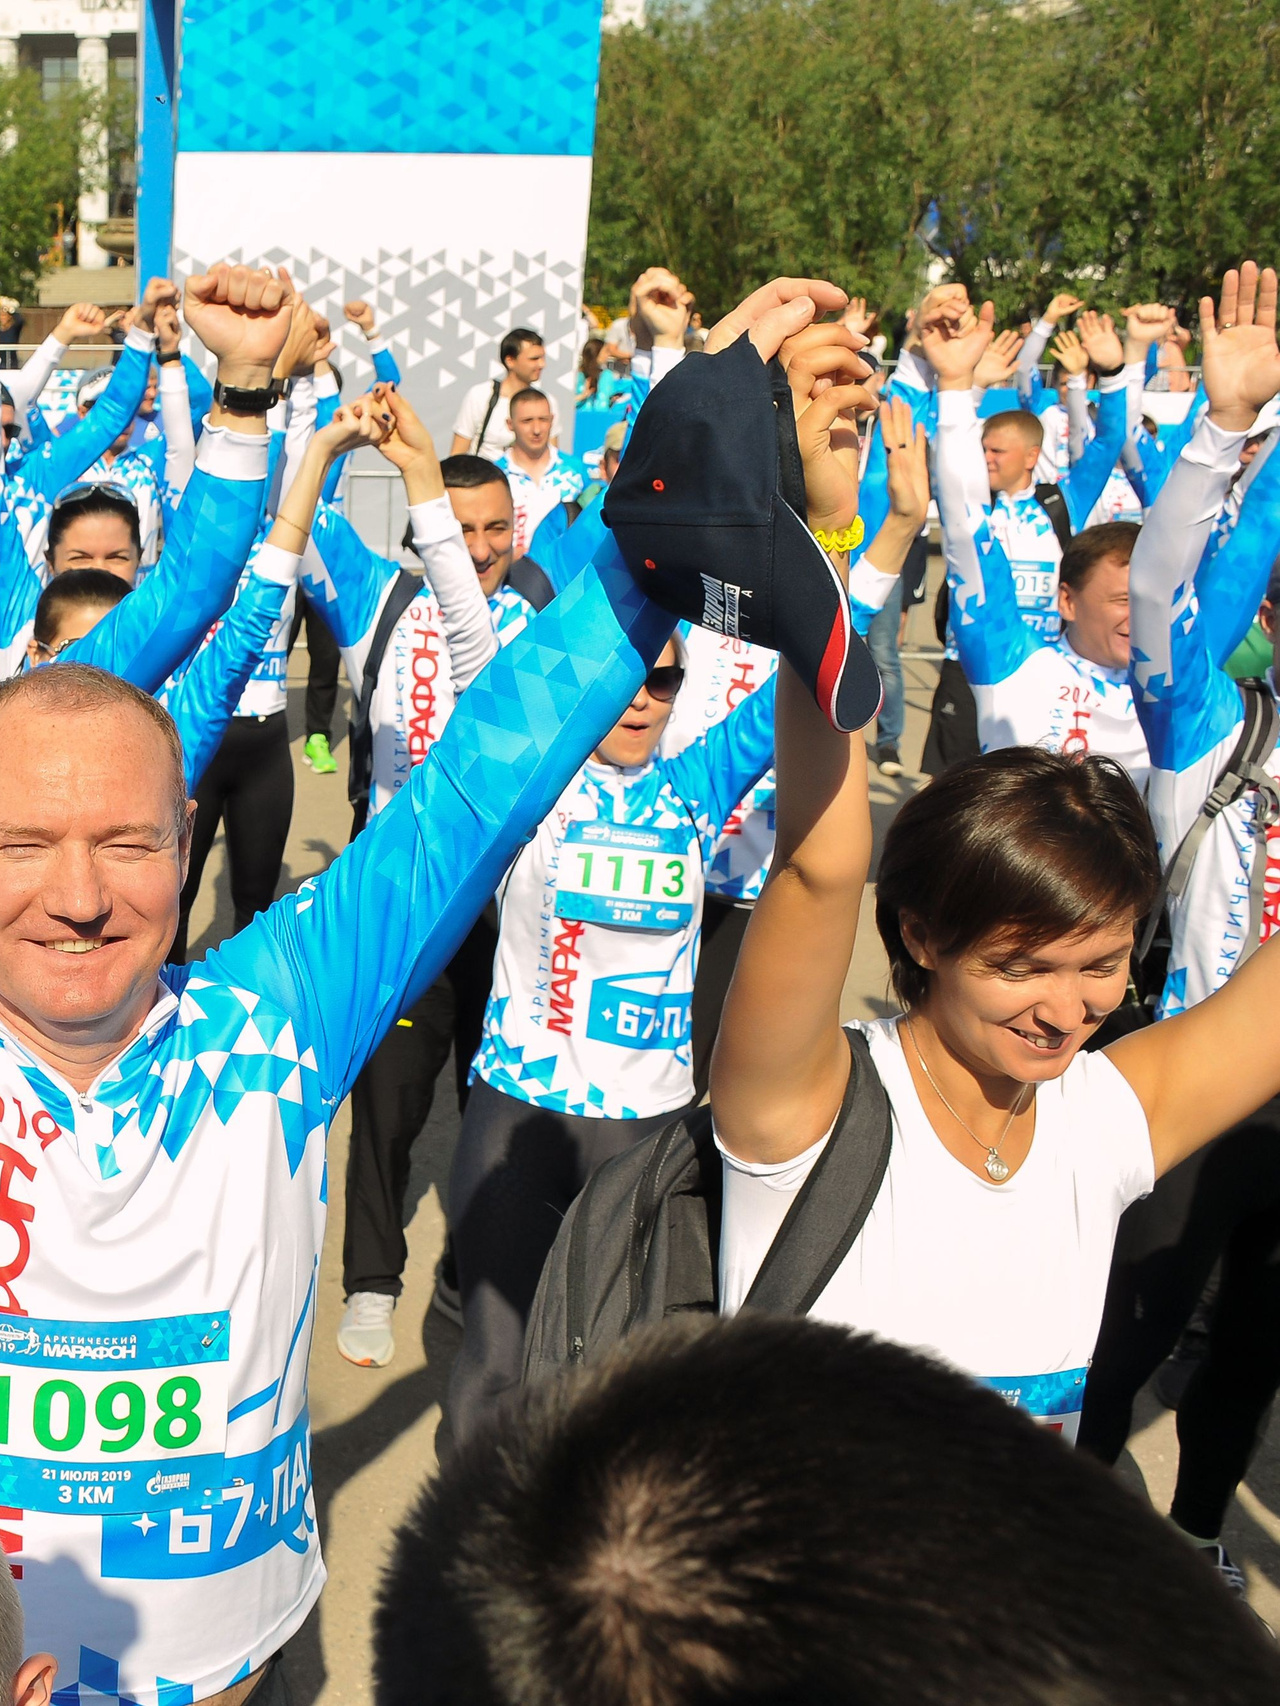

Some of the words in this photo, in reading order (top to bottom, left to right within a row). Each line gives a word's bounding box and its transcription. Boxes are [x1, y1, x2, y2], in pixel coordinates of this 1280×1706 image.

[577, 852, 684, 897] 1113
[616, 1001, 657, 1040] 67
[43, 1335, 137, 1345] АРКТИЧЕСКИЙ
[43, 1343, 137, 1360] МАРАФОН
[42, 1468, 56, 1480] 21
[60, 1469, 99, 1481] ИЮЛЯ
[101, 1470, 132, 1481] 2019
[58, 1485, 73, 1503] 3
[78, 1486, 114, 1504] КМ
